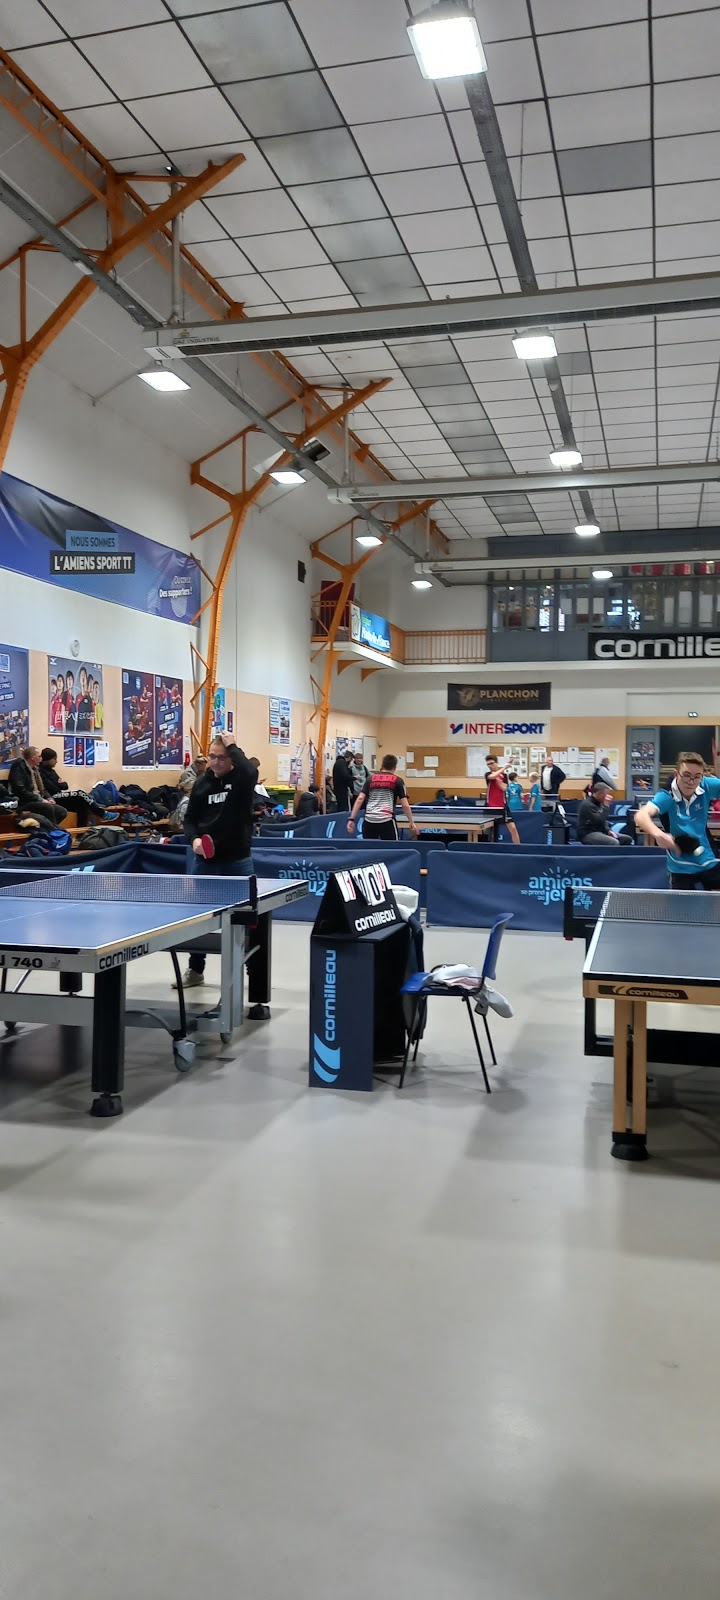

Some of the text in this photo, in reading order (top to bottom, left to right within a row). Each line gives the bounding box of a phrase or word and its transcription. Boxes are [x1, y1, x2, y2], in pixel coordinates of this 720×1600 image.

[70, 536, 115, 548] NOUS SOMMES
[54, 555, 132, 571] L'AMIENS SPORT TT
[159, 588, 168, 598] Des
[168, 588, 190, 599] supporters
[480, 690, 539, 698] PLANCHON
[465, 723, 545, 734] INTERSPORT
[528, 874, 593, 889] amiens
[355, 909, 396, 932] cornilleau
[11, 957, 43, 968] 740
[99, 943, 149, 970] cornilleau
[325, 950, 337, 1041] cornilleau
[629, 988, 679, 998] cornilleau
